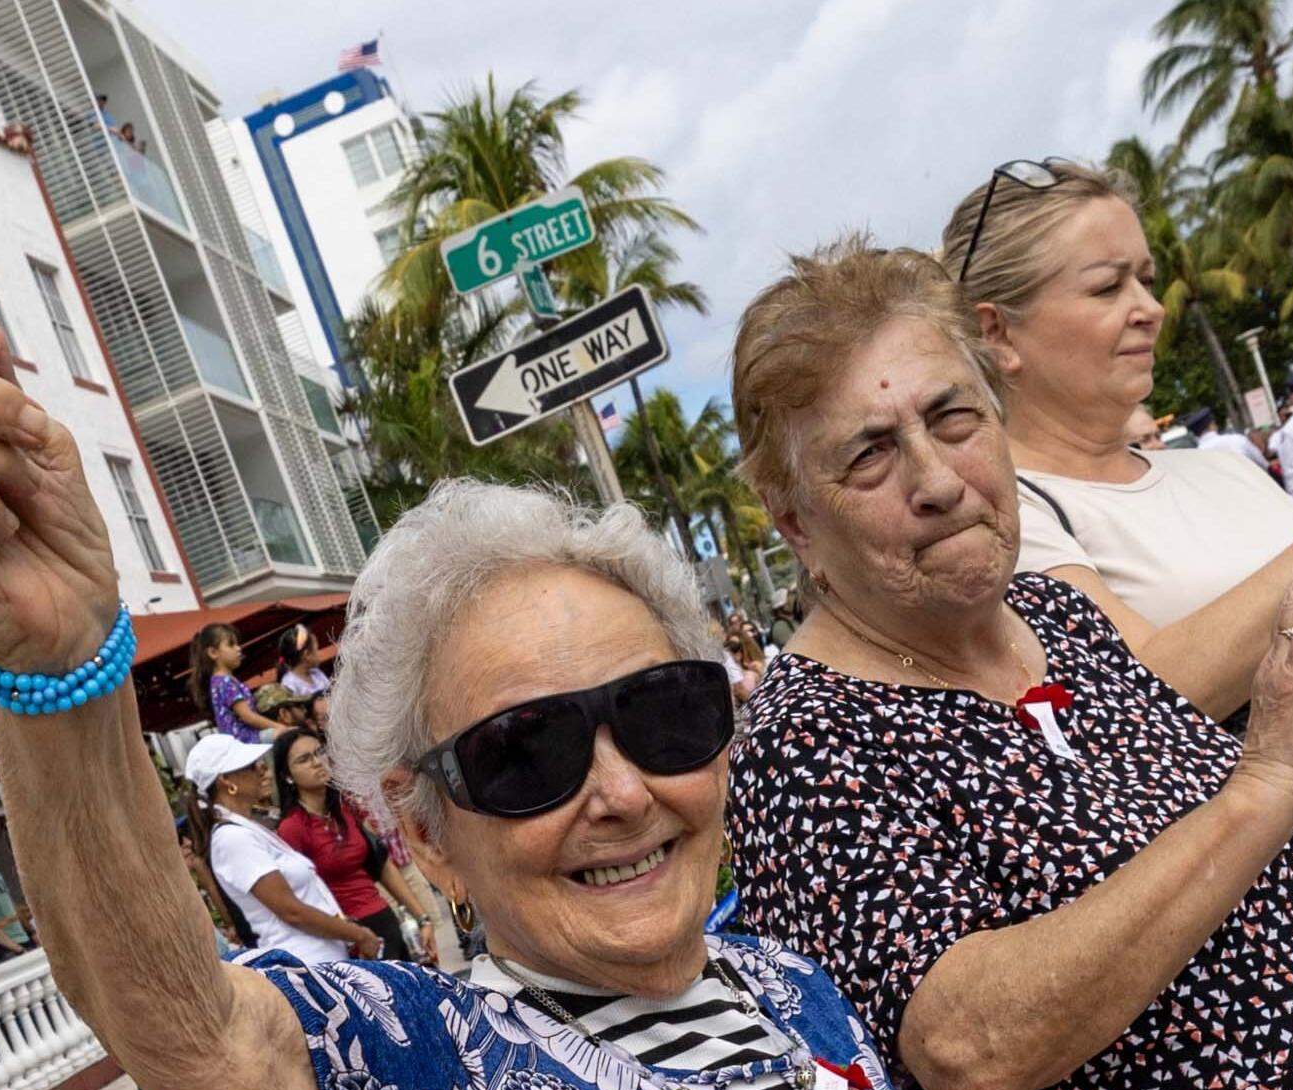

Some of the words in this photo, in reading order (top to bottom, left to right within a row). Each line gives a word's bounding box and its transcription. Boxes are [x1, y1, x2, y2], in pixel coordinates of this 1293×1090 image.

[477, 236, 502, 276] 6
[512, 206, 586, 261] STREET
[521, 350, 578, 394] ONE
[583, 318, 634, 366] WAY
